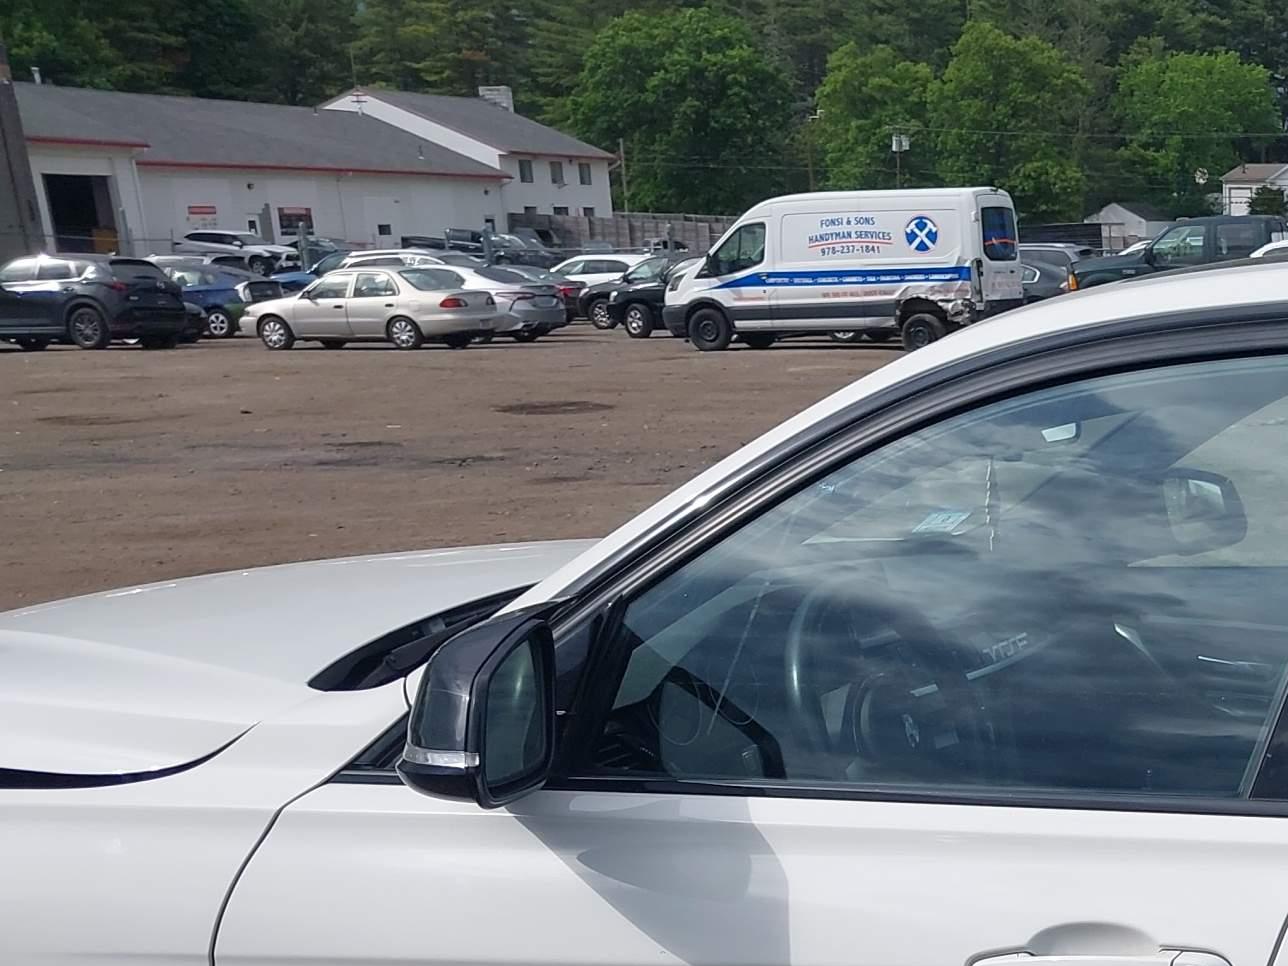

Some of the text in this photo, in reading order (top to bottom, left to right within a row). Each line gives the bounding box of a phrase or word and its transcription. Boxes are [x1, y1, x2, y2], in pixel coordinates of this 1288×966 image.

[820, 216, 875, 228] FONSI & SONS
[808, 230, 892, 244] HANDYMAN SERVICES
[820, 245, 880, 256] 978-237-1841
